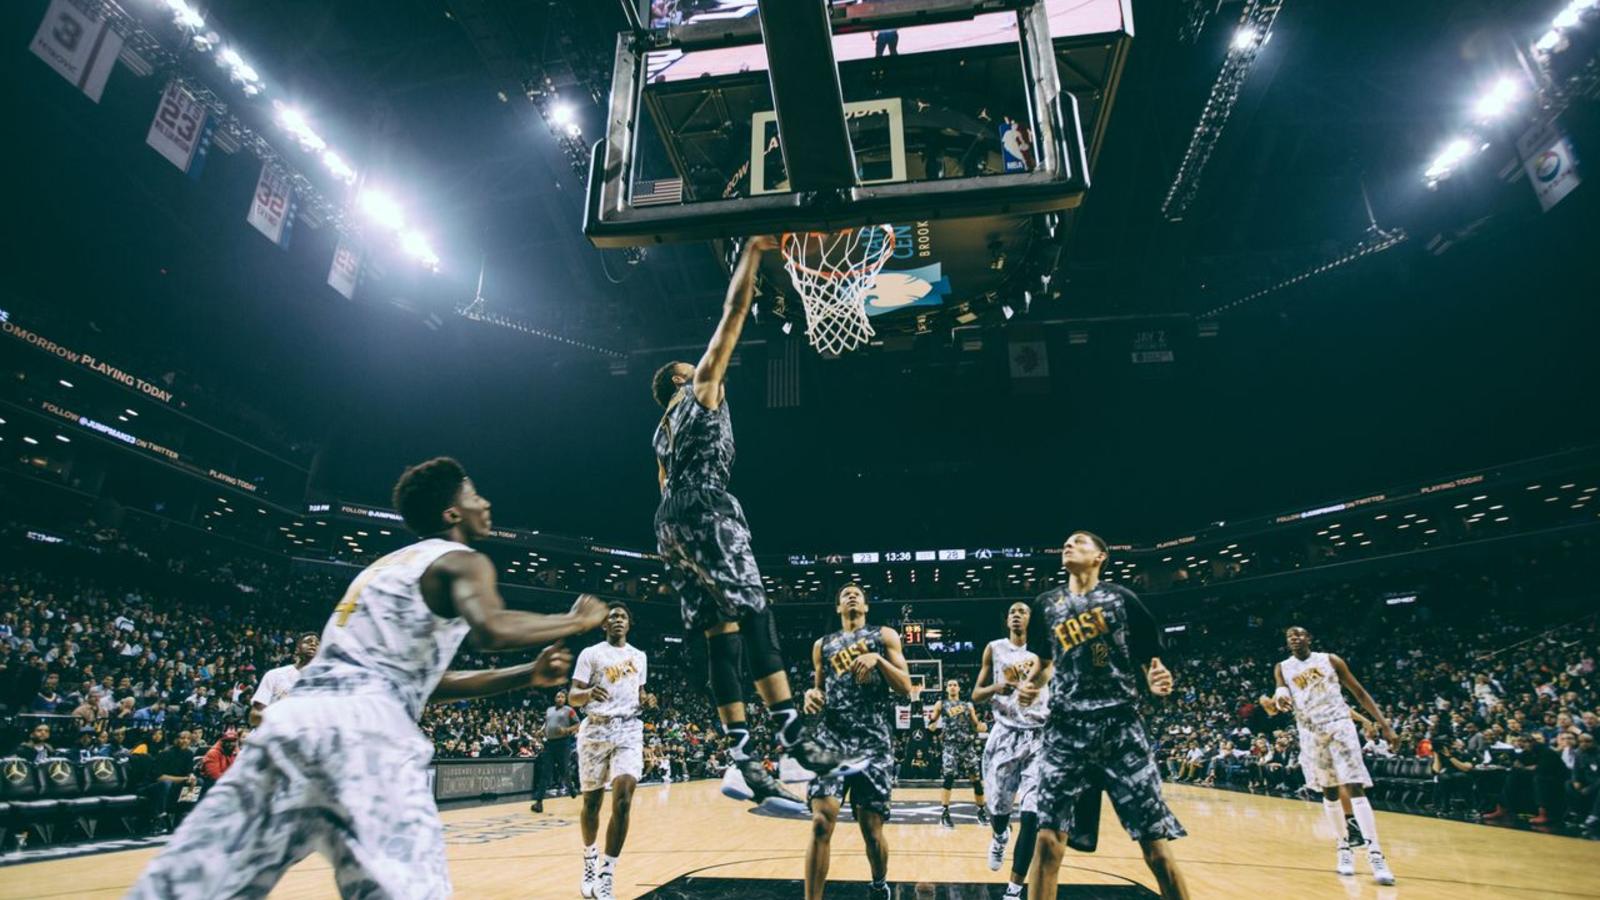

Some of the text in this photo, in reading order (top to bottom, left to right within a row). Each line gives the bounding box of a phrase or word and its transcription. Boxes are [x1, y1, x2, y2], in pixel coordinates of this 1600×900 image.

[53, 12, 83, 52] 3
[160, 98, 197, 142] 23
[257, 182, 285, 218] 32
[917, 220, 931, 257] BROOK
[1, 320, 173, 403] OMORROW PLAYING TODAY
[42, 402, 79, 421] FOLLOW
[136, 438, 148, 448] ON
[148, 441, 179, 460] TWITTER
[209, 469, 257, 491] PLAYING TODAY
[342, 505, 367, 515] FOLLOW
[905, 632, 921, 644] 31
[1055, 606, 1109, 652] EAST
